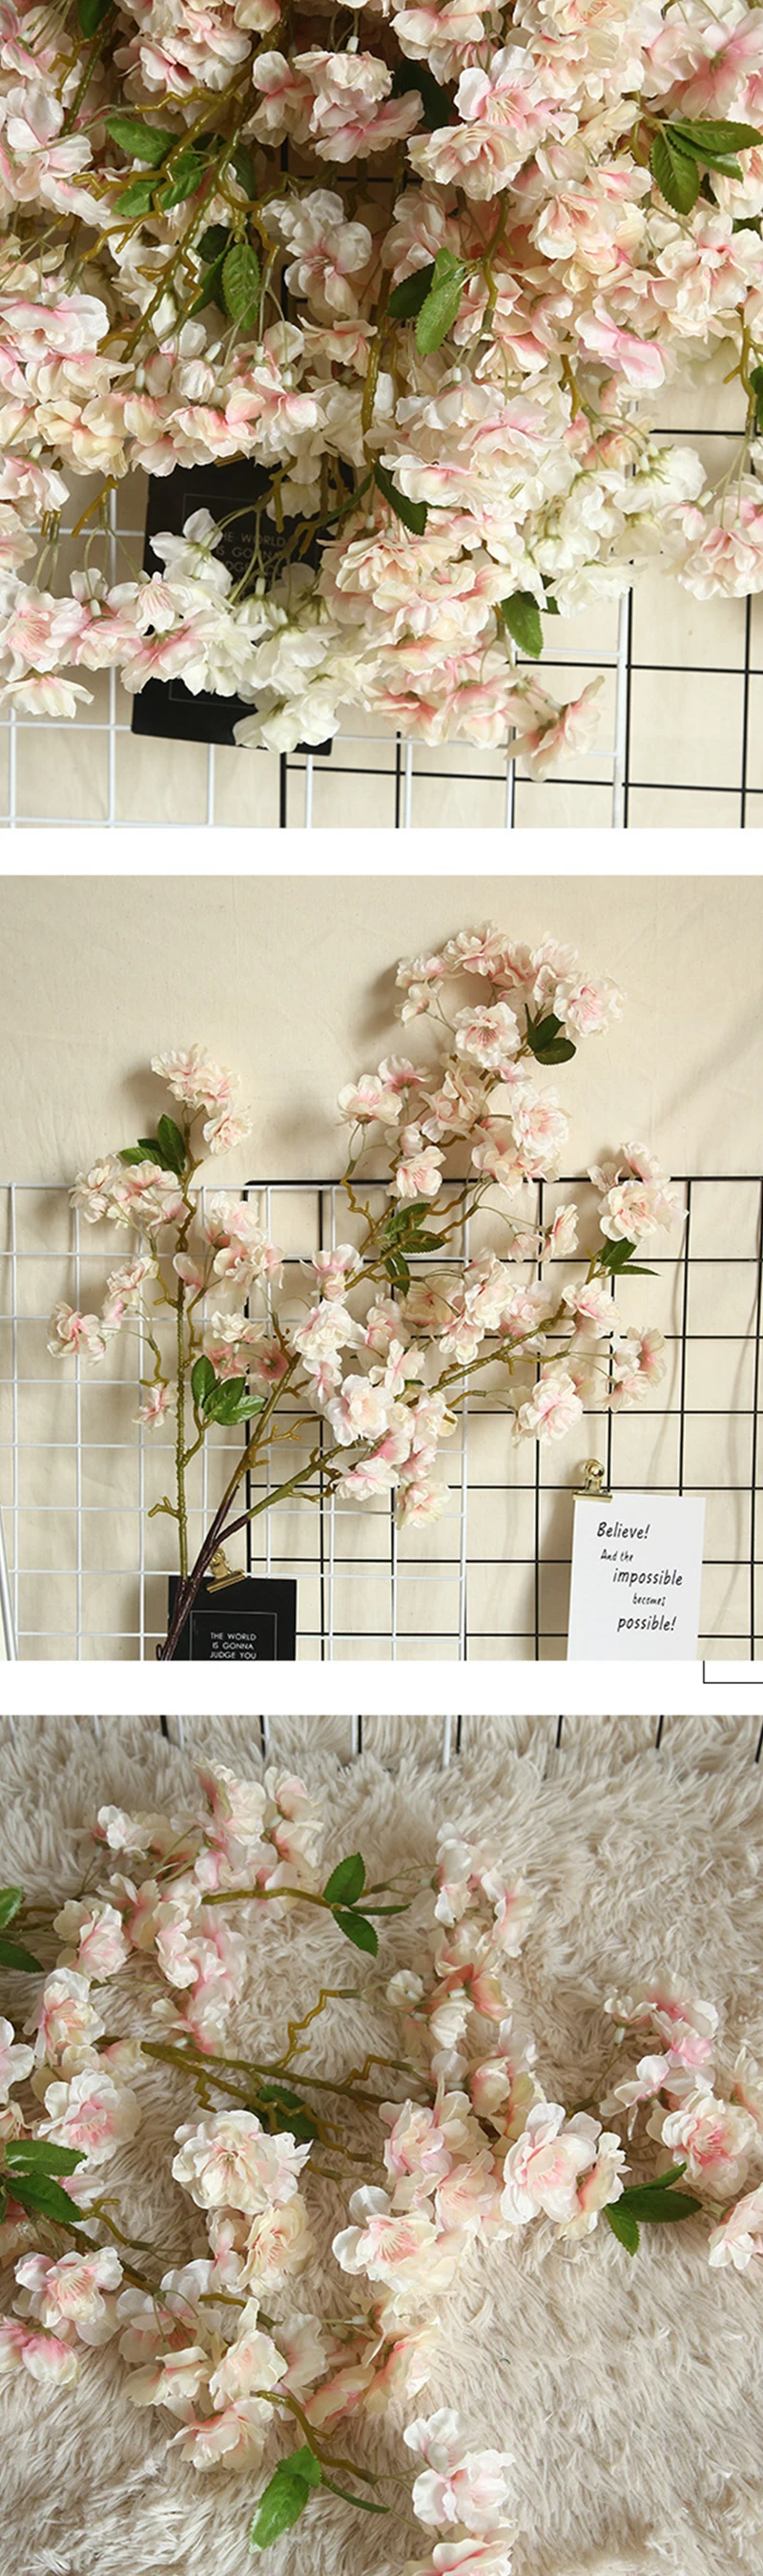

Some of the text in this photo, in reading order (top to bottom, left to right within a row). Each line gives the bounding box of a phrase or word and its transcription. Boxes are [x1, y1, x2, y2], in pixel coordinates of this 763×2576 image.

[240, 532, 286, 548] WORLD
[596, 1521, 650, 1540] Believe!
[600, 1548, 634, 1563] And the
[612, 1568, 683, 1588] impossible
[616, 1614, 677, 1632] possible!
[210, 1631, 258, 1641] THE WORLD
[212, 1641, 255, 1651] IS GONNA
[209, 1651, 258, 1660] JUDGE YOU
